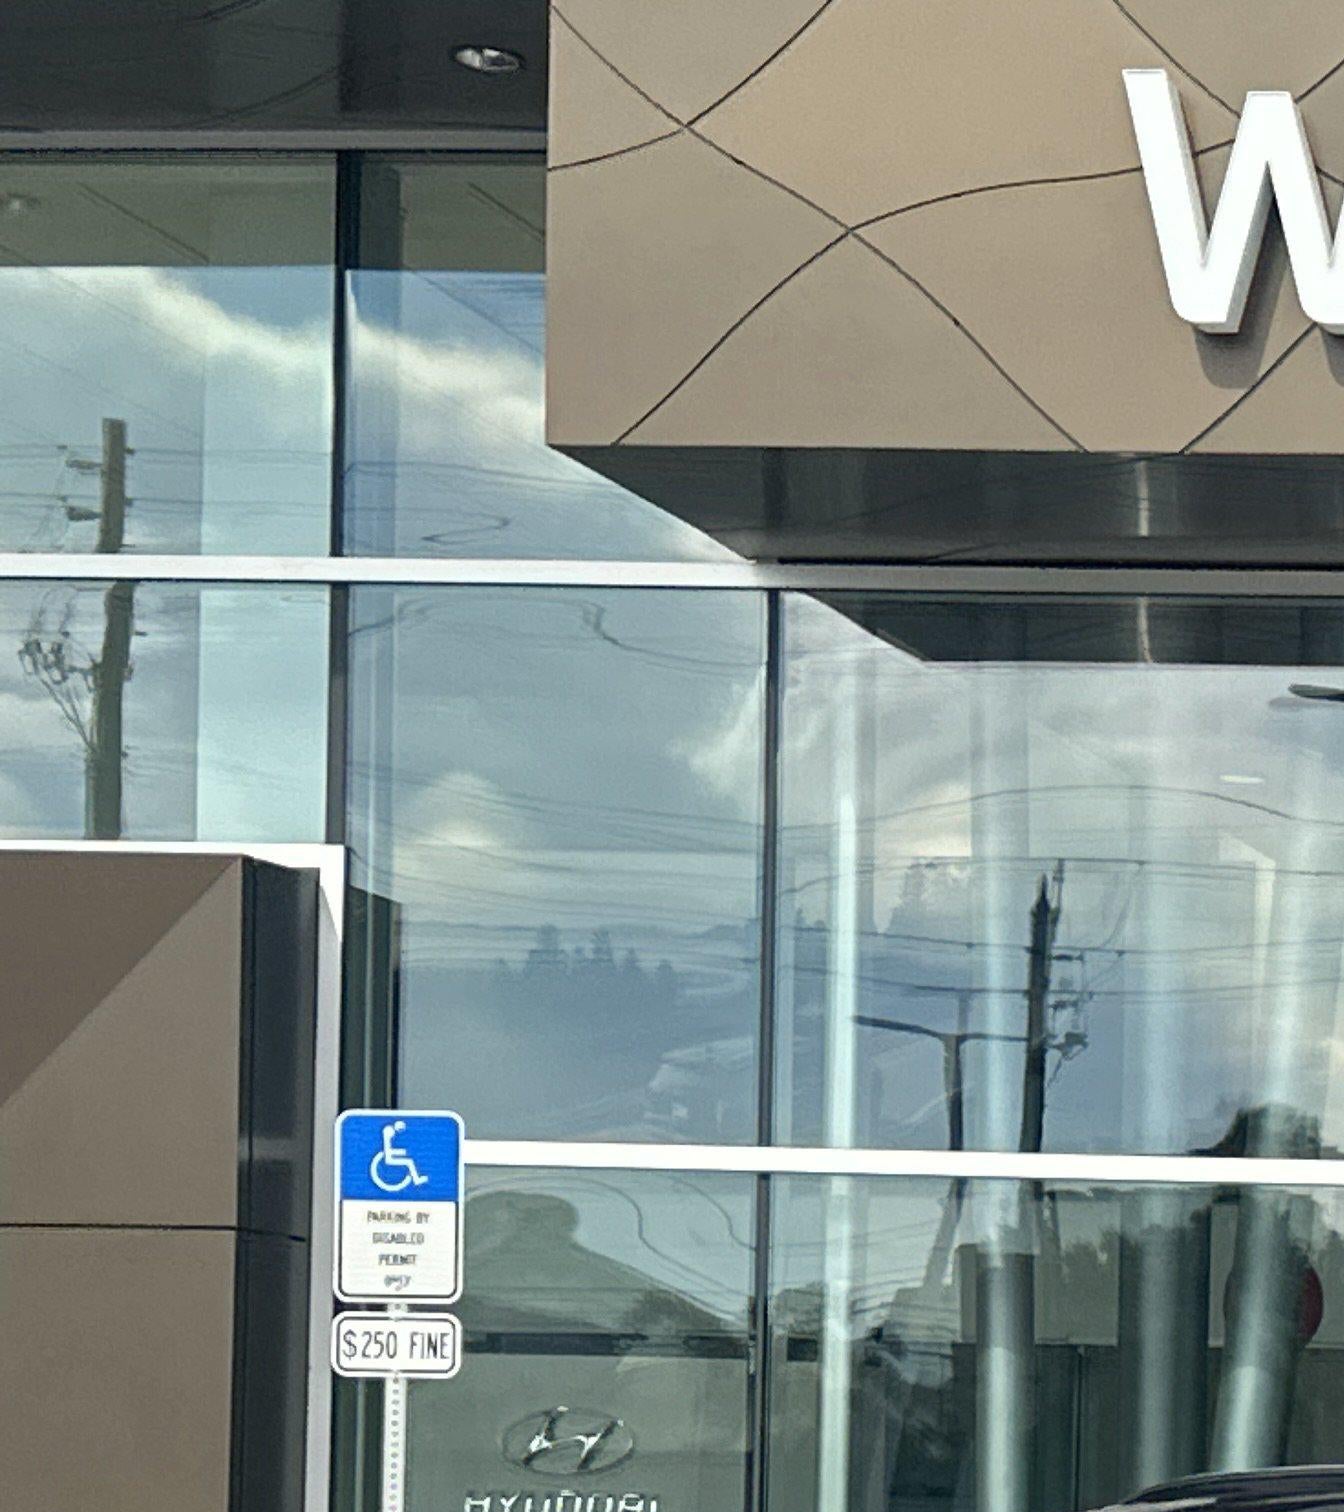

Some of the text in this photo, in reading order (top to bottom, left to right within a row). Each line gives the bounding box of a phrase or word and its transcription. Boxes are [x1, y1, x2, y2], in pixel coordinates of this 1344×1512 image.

[416, 1211, 431, 1225] BY
[342, 1329, 450, 1361] $250 FINE
